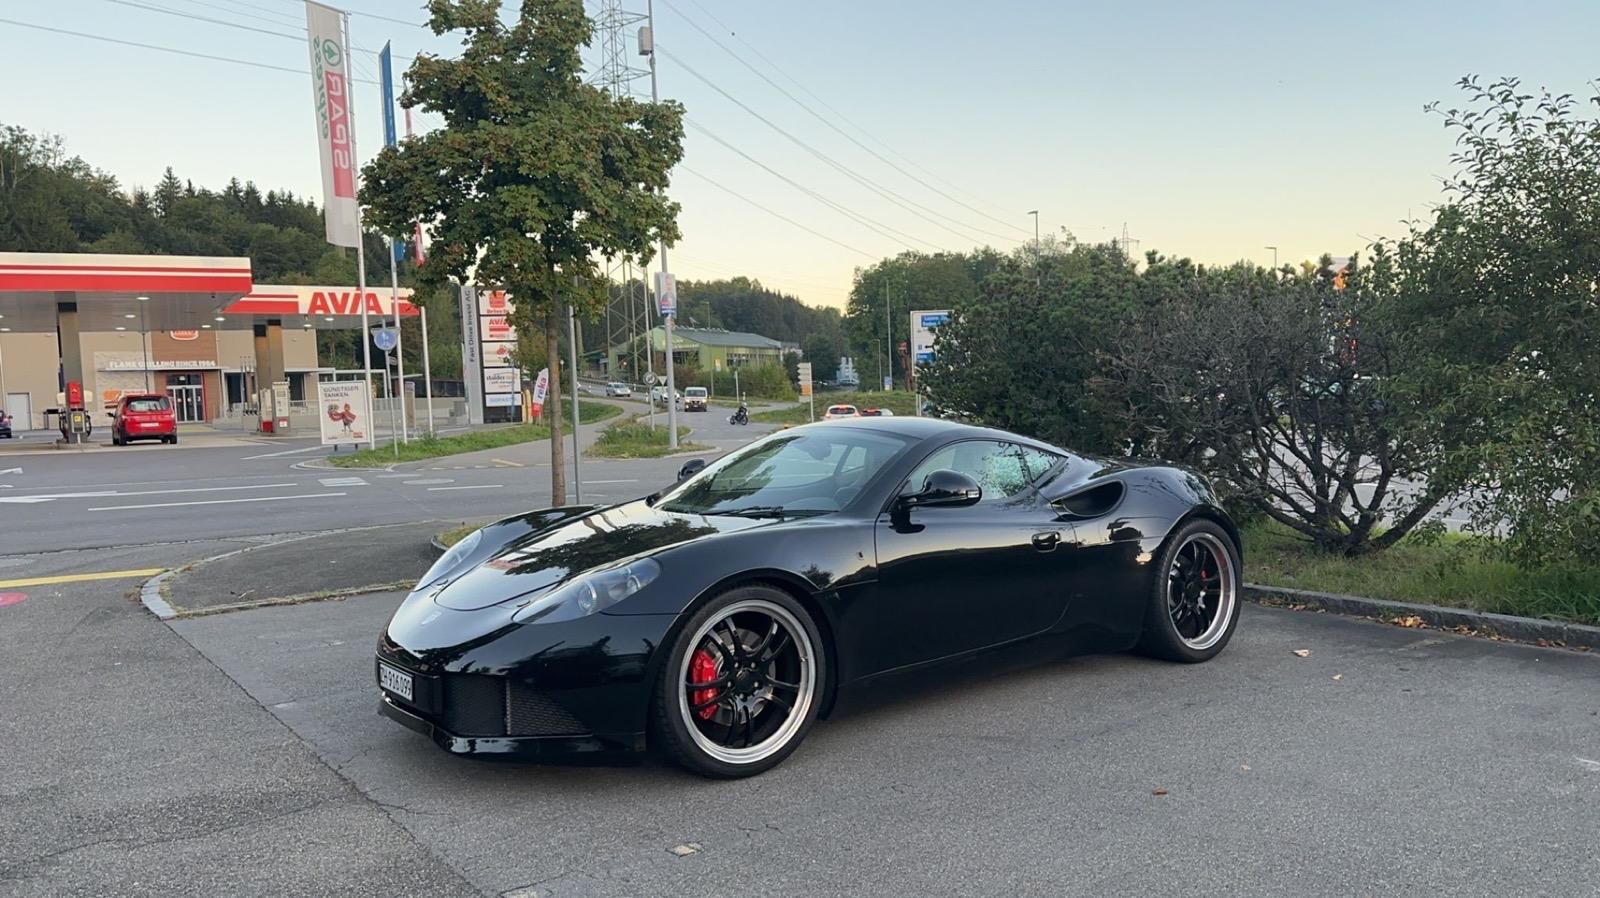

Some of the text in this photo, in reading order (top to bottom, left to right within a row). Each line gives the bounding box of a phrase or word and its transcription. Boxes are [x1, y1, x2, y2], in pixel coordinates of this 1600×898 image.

[307, 285, 385, 316] AVIA
[464, 290, 471, 302] AG
[537, 377, 547, 400] reka
